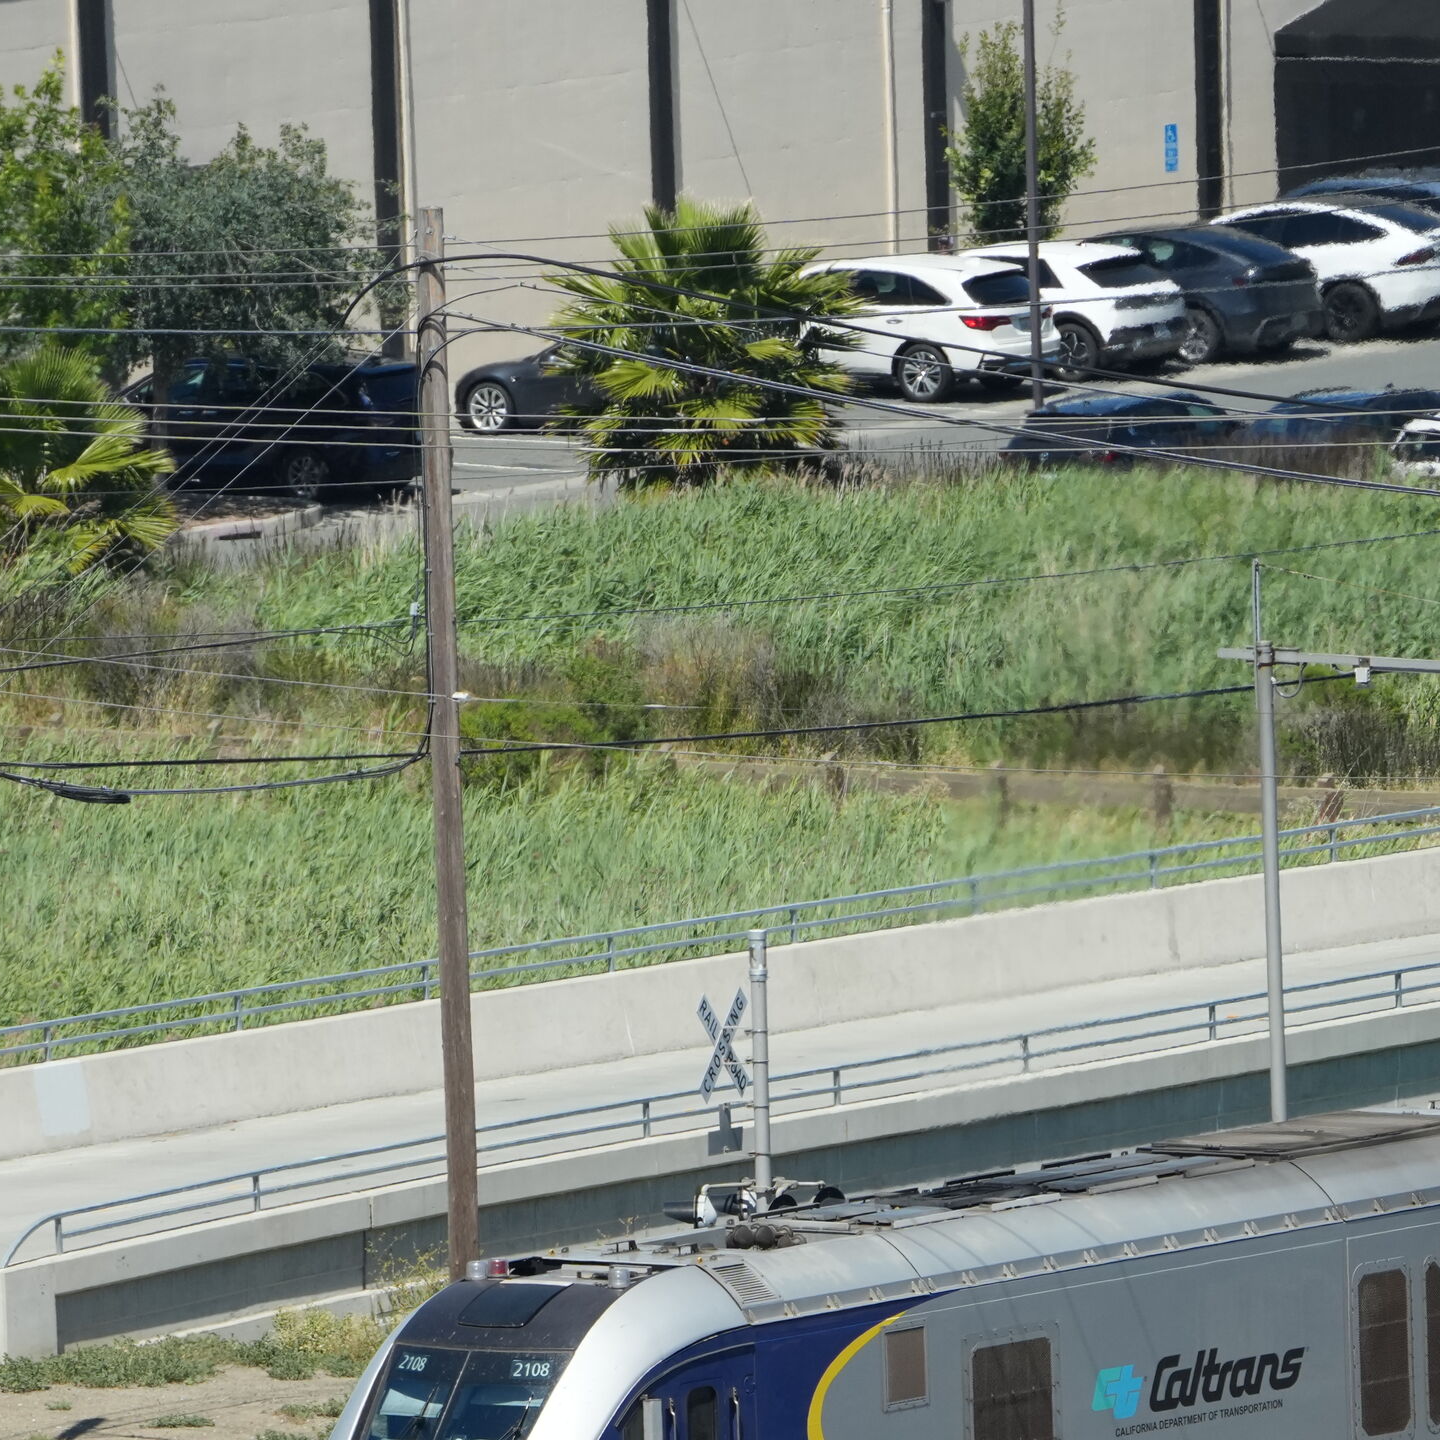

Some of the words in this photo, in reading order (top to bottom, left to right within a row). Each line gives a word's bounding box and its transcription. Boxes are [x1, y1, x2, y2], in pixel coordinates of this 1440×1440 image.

[700, 999, 718, 1041] RAIL
[726, 1051, 748, 1091] ROAD
[703, 996, 744, 1093] CROSSING
[398, 1354, 428, 1372] 2108
[512, 1361, 551, 1377] 2108
[1149, 1346, 1306, 1413] Caltrans
[1115, 1421, 1158, 1438] CALIFORNIA
[1158, 1412, 1207, 1430] DEPARTMENT
[1208, 1410, 1219, 1421] OF
[1220, 1399, 1284, 1419] TRANSPORTATION
